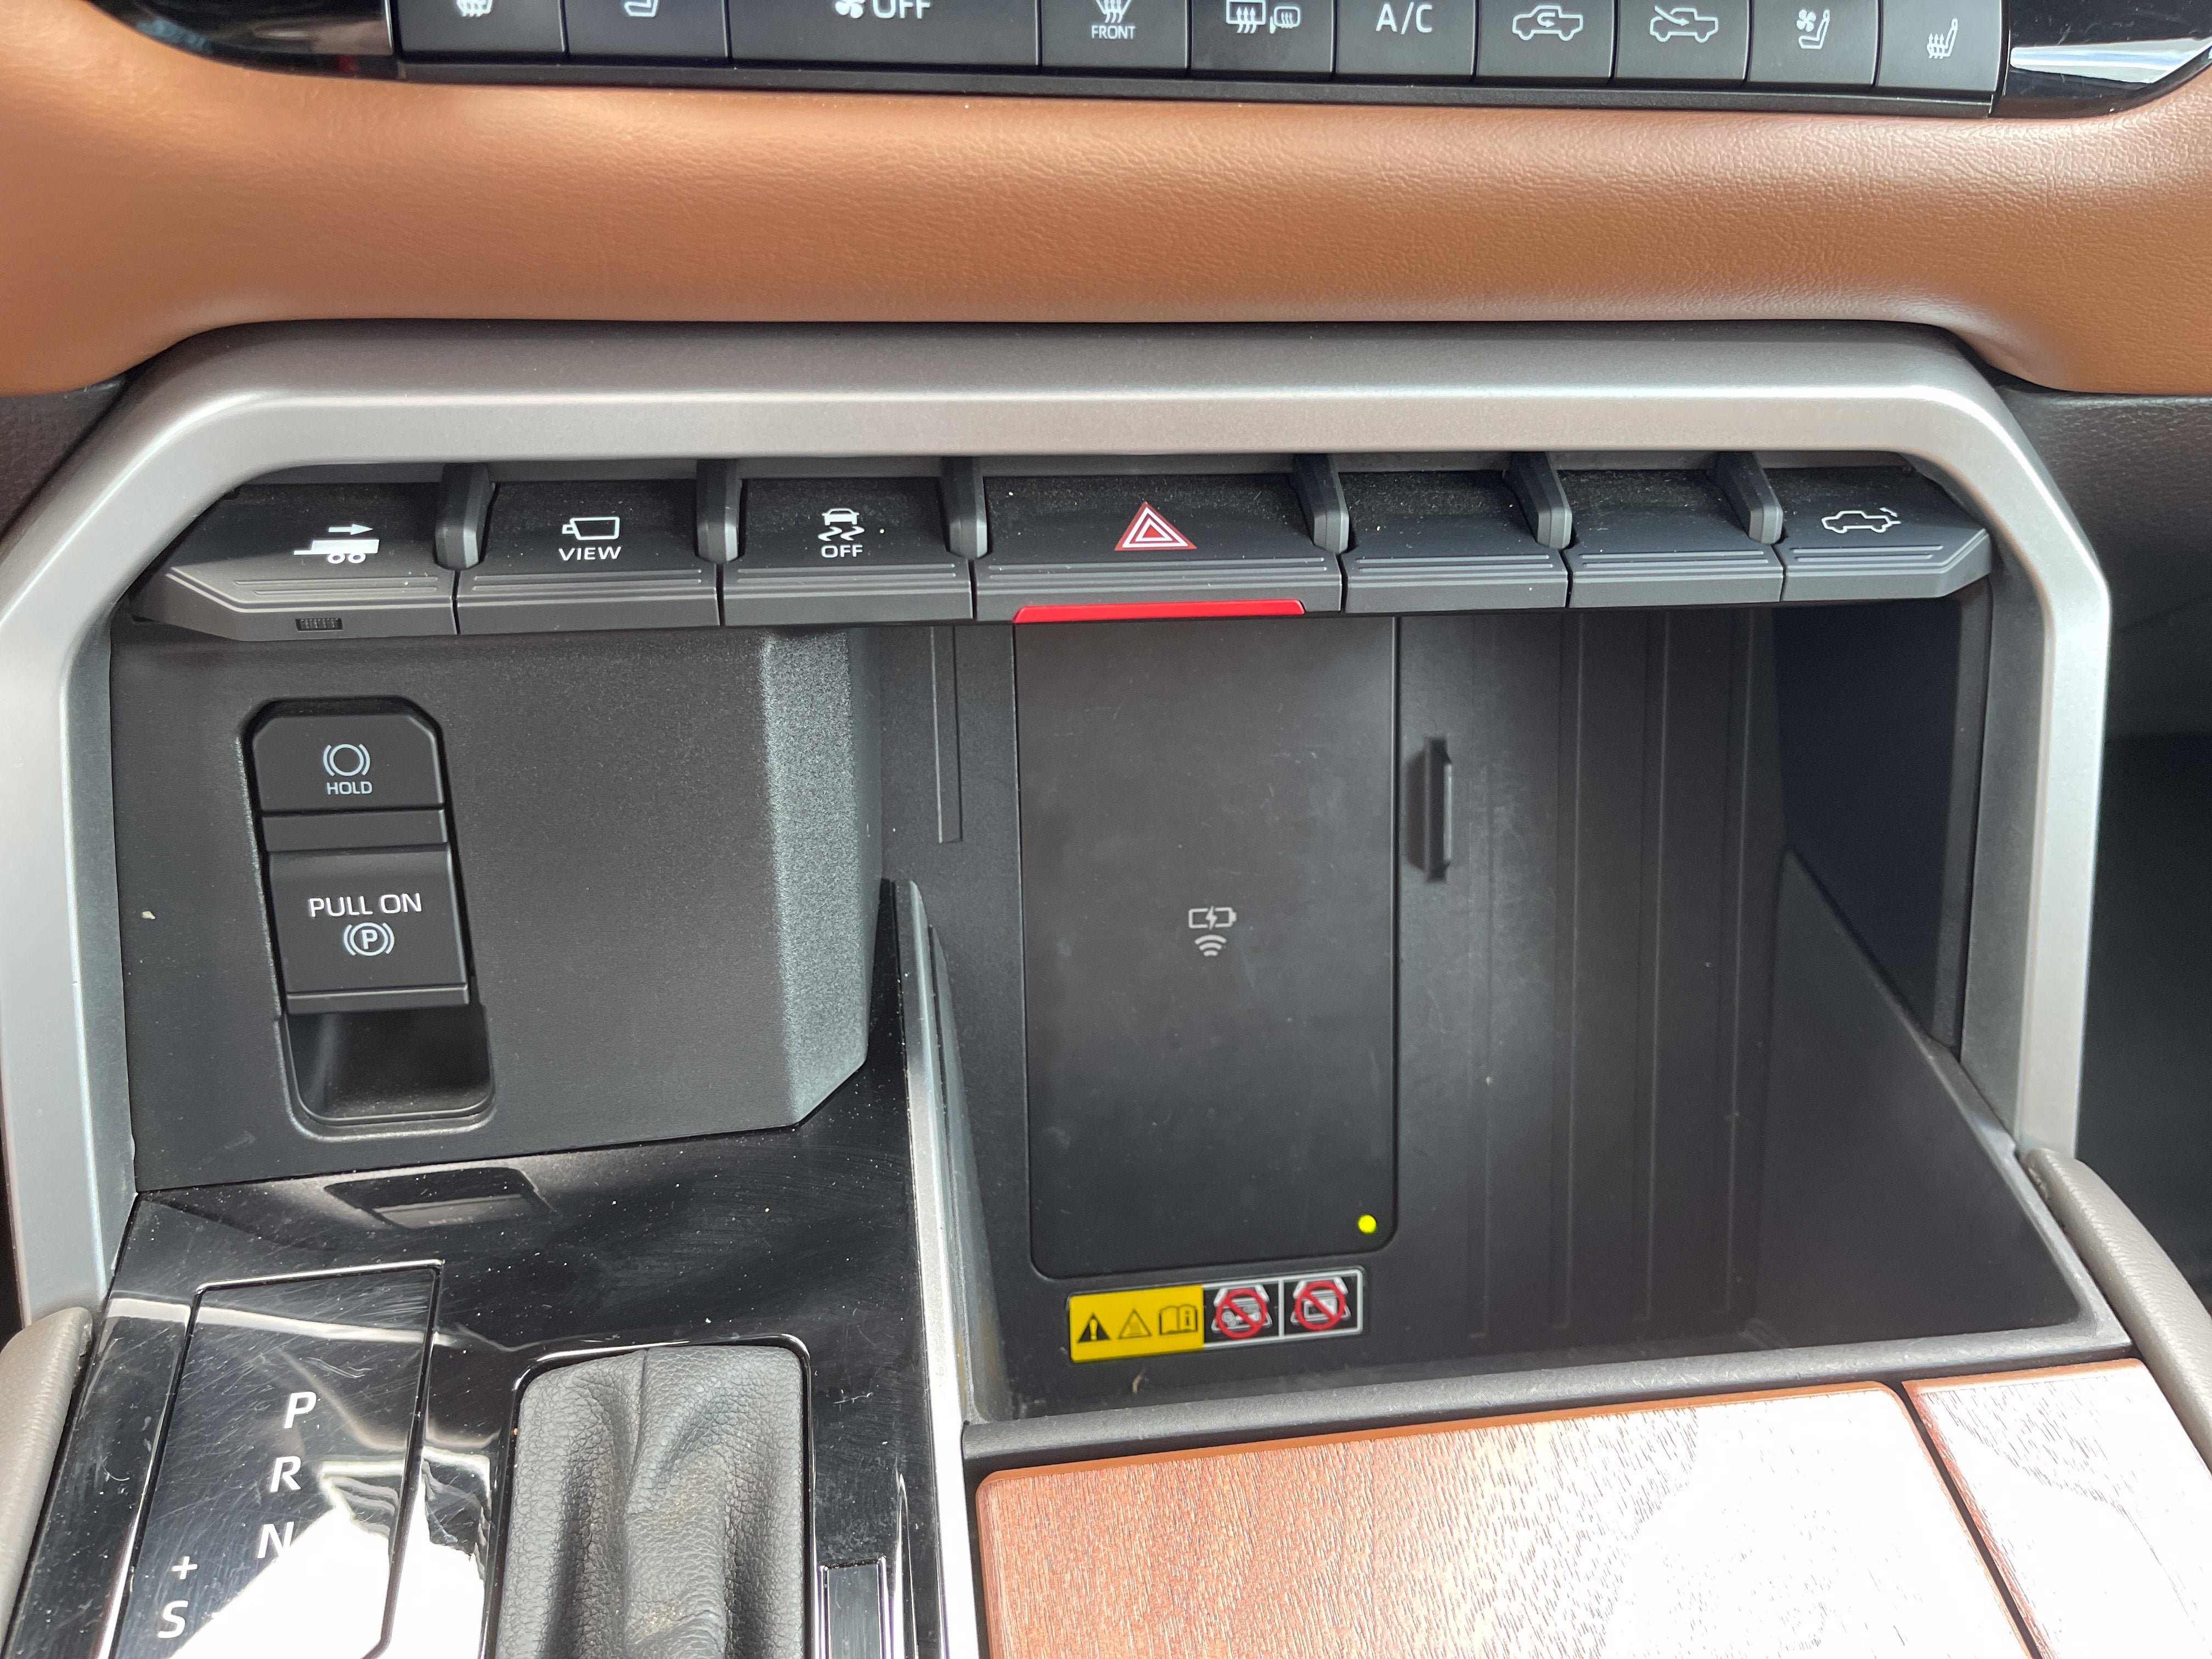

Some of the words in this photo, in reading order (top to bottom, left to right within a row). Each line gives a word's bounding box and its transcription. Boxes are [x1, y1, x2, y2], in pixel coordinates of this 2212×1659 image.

[872, 0, 931, 19] OFF
[1375, 2, 1434, 35] A/C
[1091, 25, 1136, 40] FRONT
[558, 546, 622, 562] VIEW
[820, 544, 864, 558] OFF
[326, 781, 373, 795] HOLD
[308, 896, 374, 917] PULL
[380, 893, 422, 913] ON
[283, 1391, 317, 1429] P
[269, 1455, 302, 1493] R
[257, 1520, 295, 1559] N
[157, 1599, 189, 1639] S
